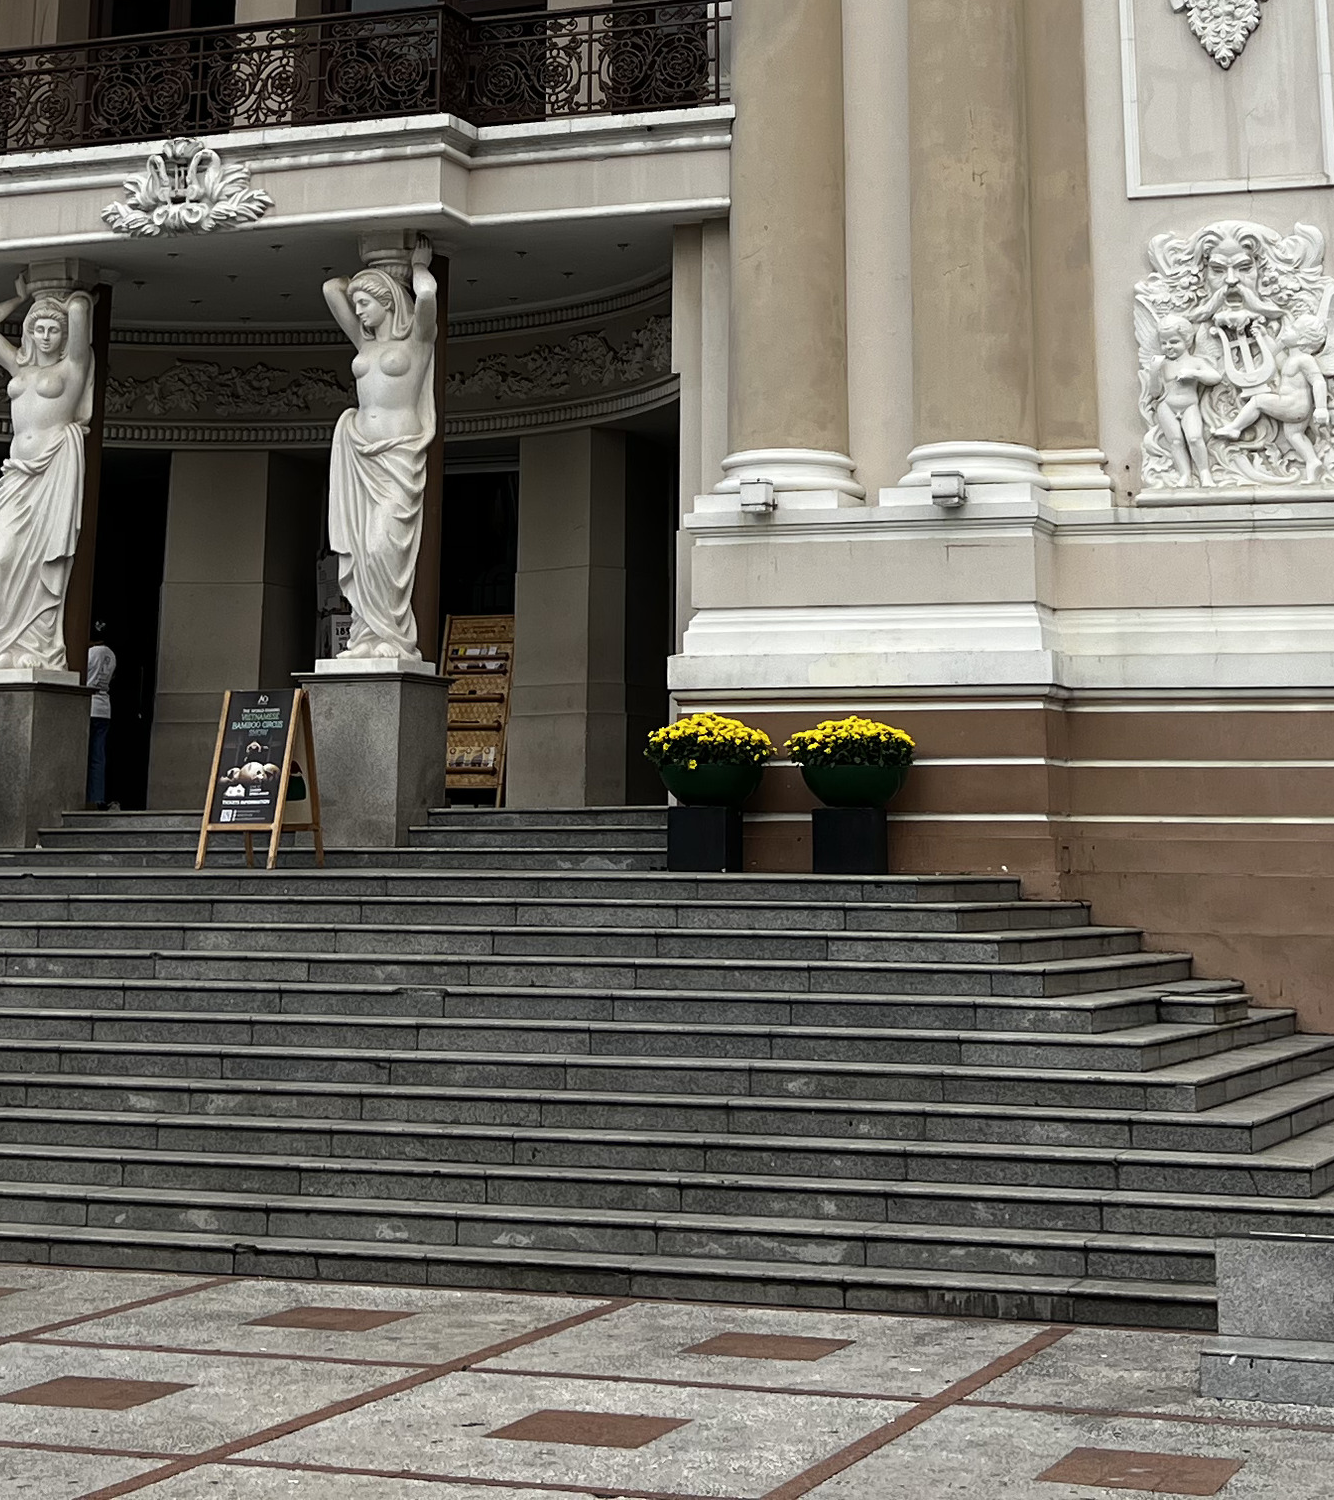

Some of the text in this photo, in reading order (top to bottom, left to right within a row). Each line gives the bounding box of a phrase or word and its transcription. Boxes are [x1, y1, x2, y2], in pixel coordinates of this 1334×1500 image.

[241, 712, 280, 721] VIETNAMESE
[232, 721, 283, 730] BAMBOO CIRCUS
